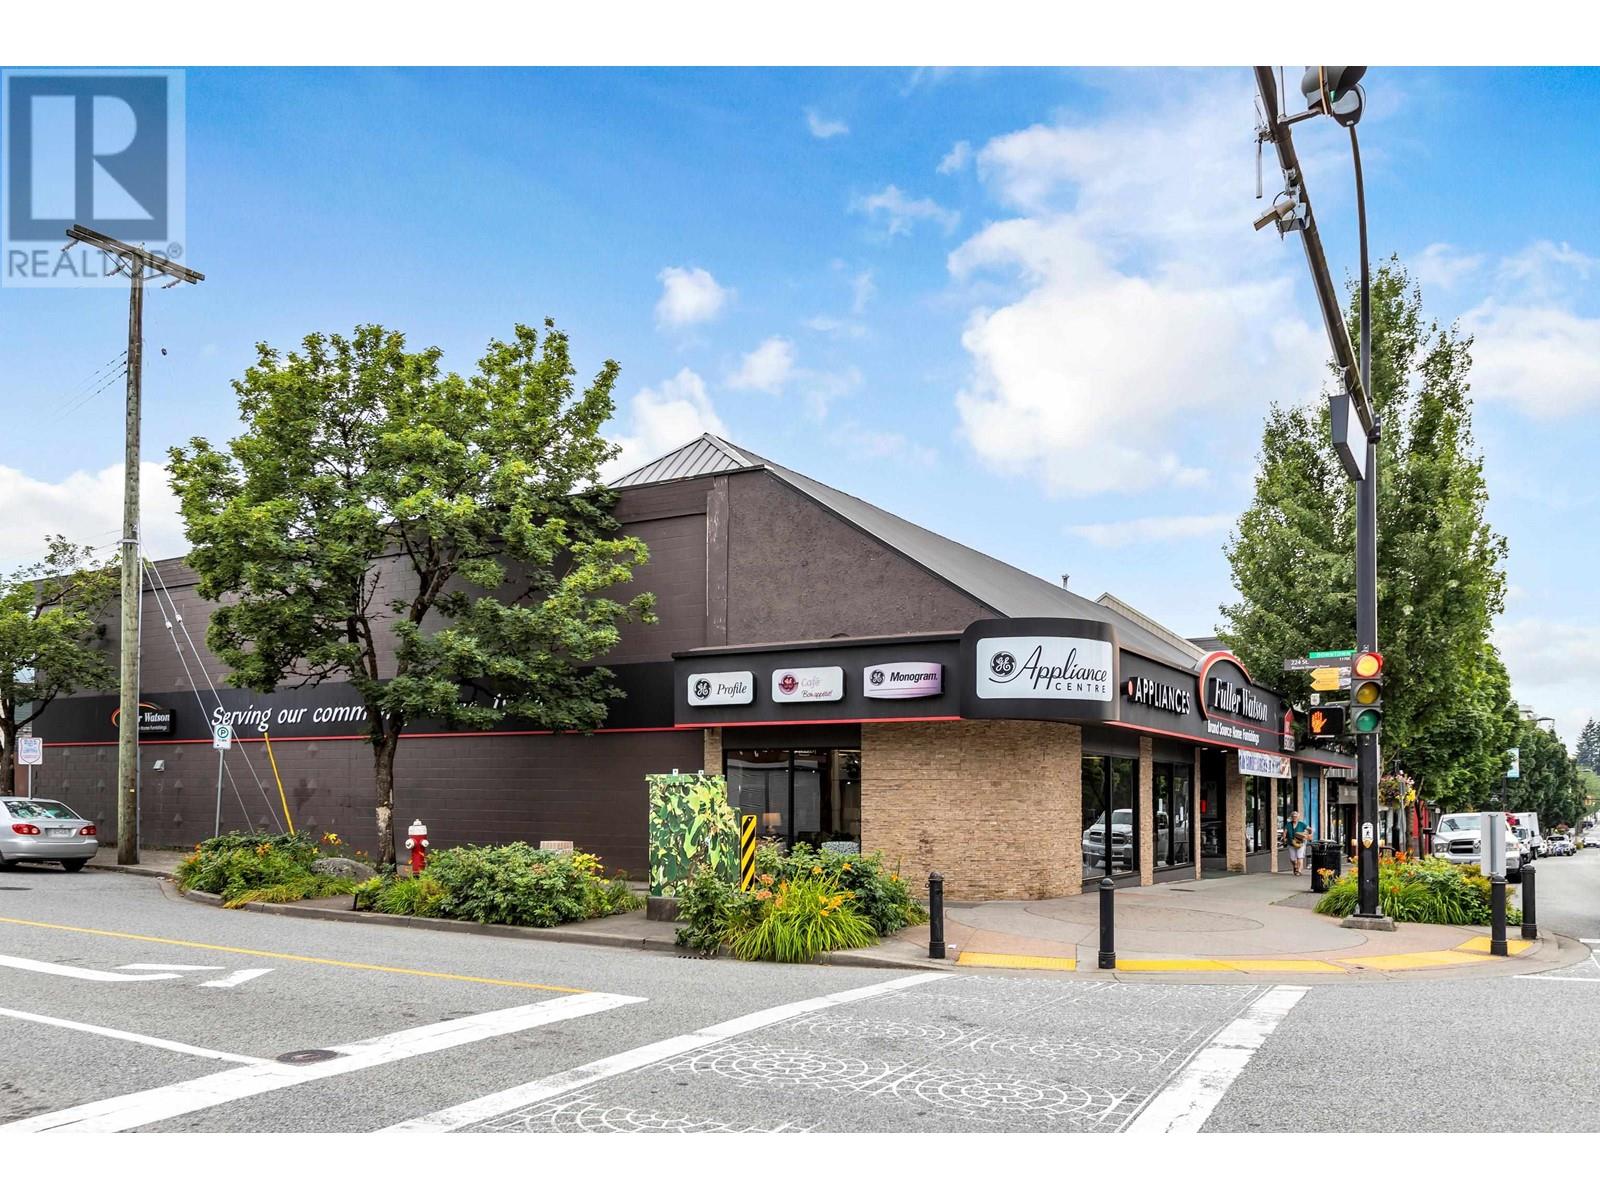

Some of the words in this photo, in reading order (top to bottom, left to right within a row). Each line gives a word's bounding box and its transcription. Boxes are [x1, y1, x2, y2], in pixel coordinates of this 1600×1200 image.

[988, 645, 1107, 690] Appliance
[716, 682, 748, 696] Profile
[1055, 682, 1106, 693] CENTRE
[1134, 677, 1190, 714] APPLIANCES
[1214, 678, 1241, 714] Fuller
[1241, 688, 1268, 722] Watson
[144, 712, 170, 723] Watson
[211, 704, 272, 732] Serving
[277, 708, 307, 724] our
